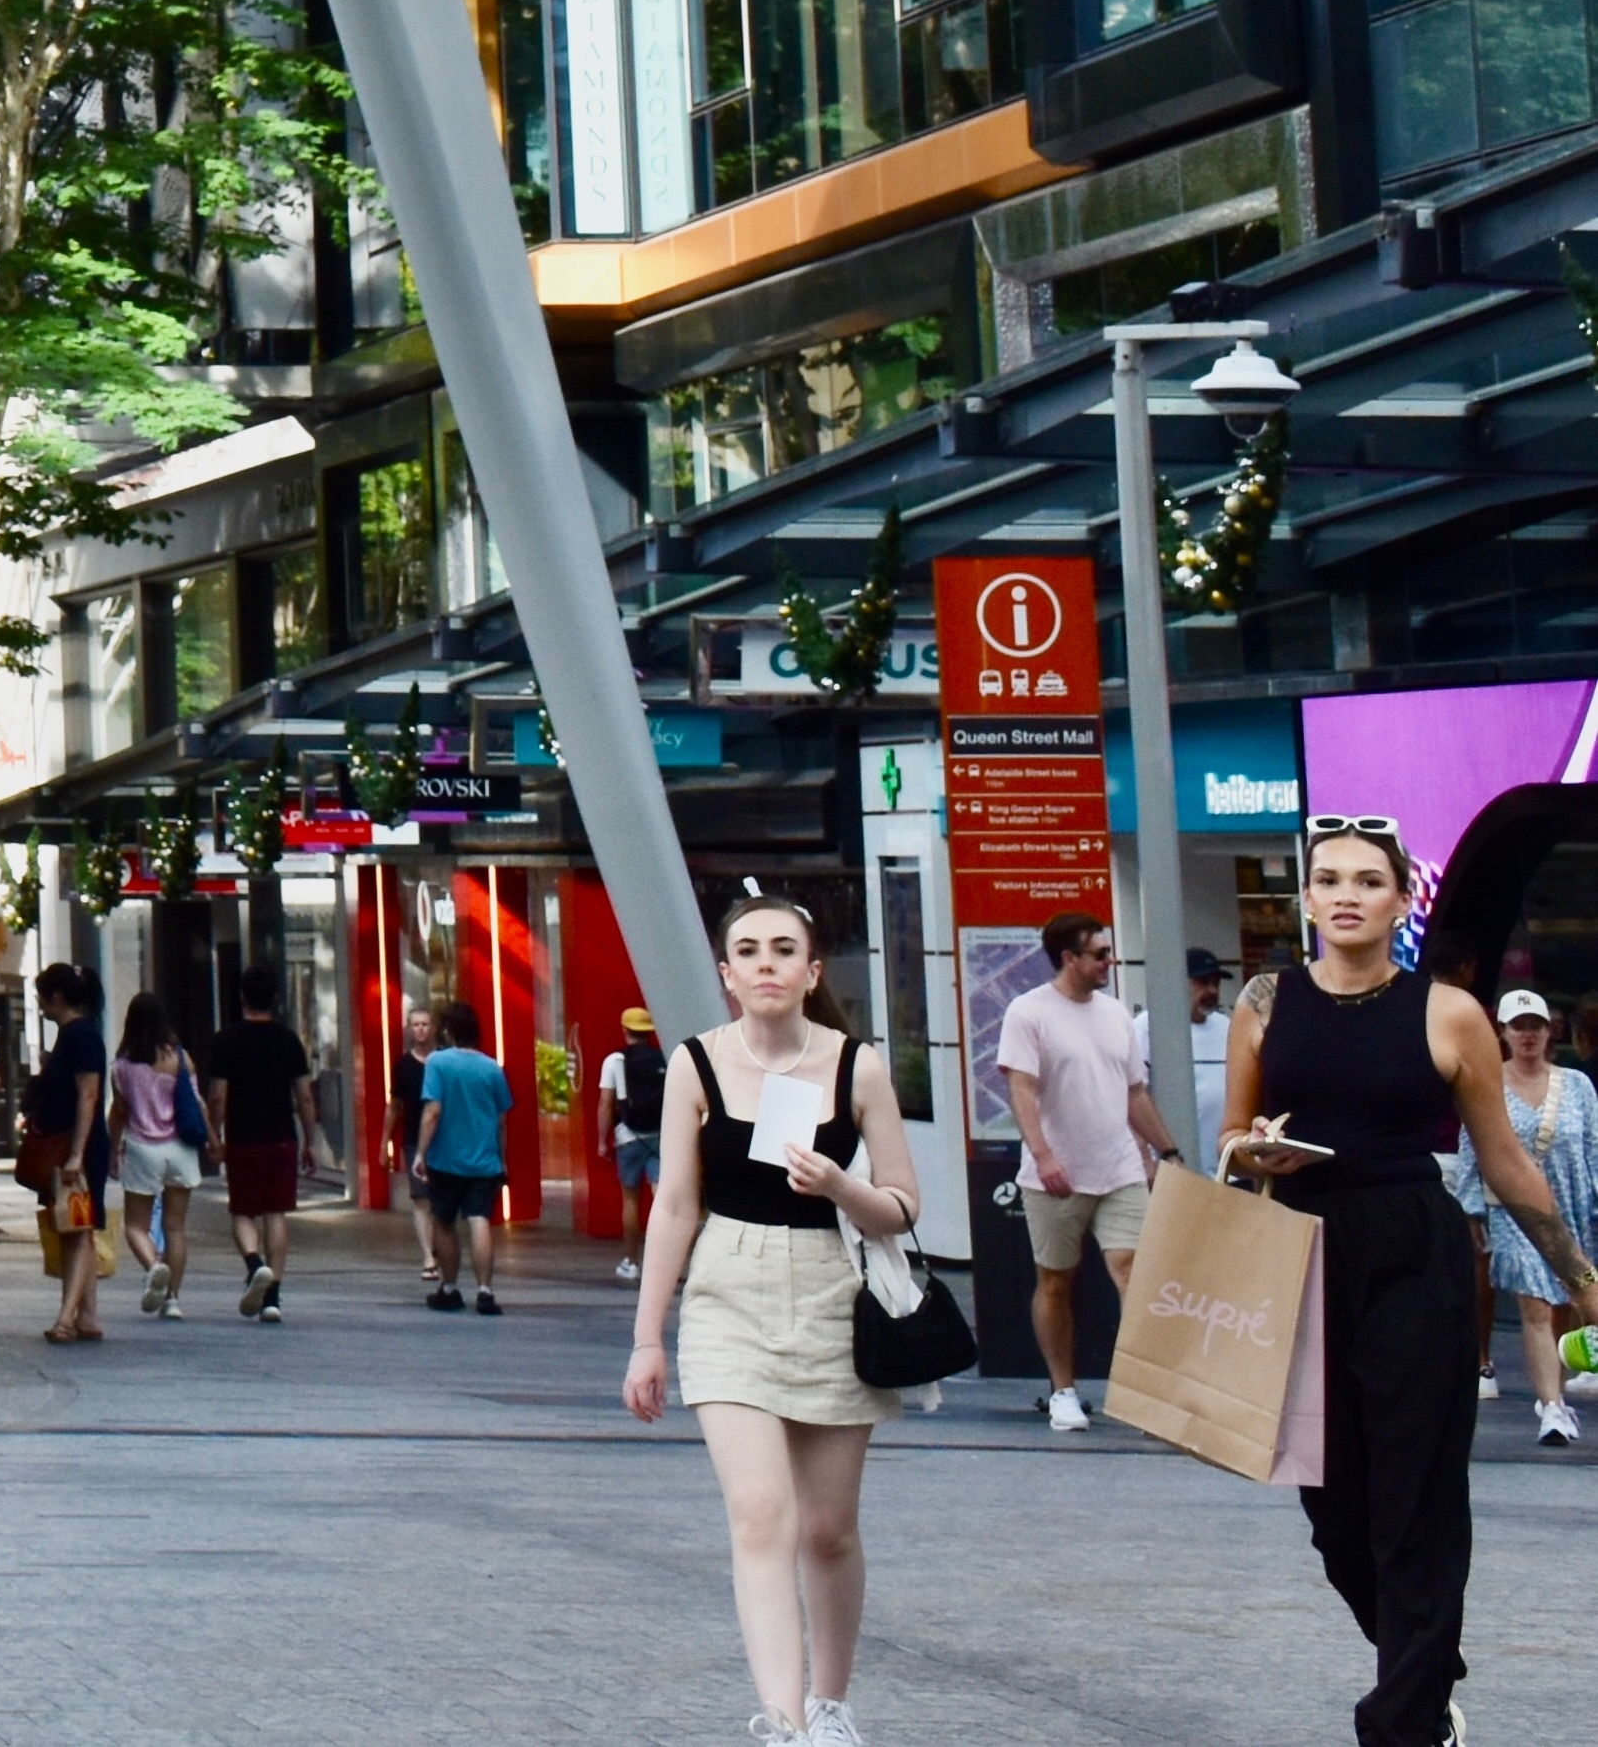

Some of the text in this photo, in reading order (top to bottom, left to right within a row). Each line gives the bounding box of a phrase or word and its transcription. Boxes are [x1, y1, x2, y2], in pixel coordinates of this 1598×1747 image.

[769, 642, 939, 679] OUS
[953, 729, 1094, 745] Queen Street Mall
[1025, 769, 1050, 777] Street
[415, 778, 490, 798] ROVSKI
[988, 805, 1075, 815] King George Square
[1008, 816, 1039, 824] station
[979, 843, 1021, 852] Elizabeth
[1022, 843, 1049, 852] Street
[994, 881, 1079, 890] Visitors Information
[1148, 1280, 1277, 1356] Supré
